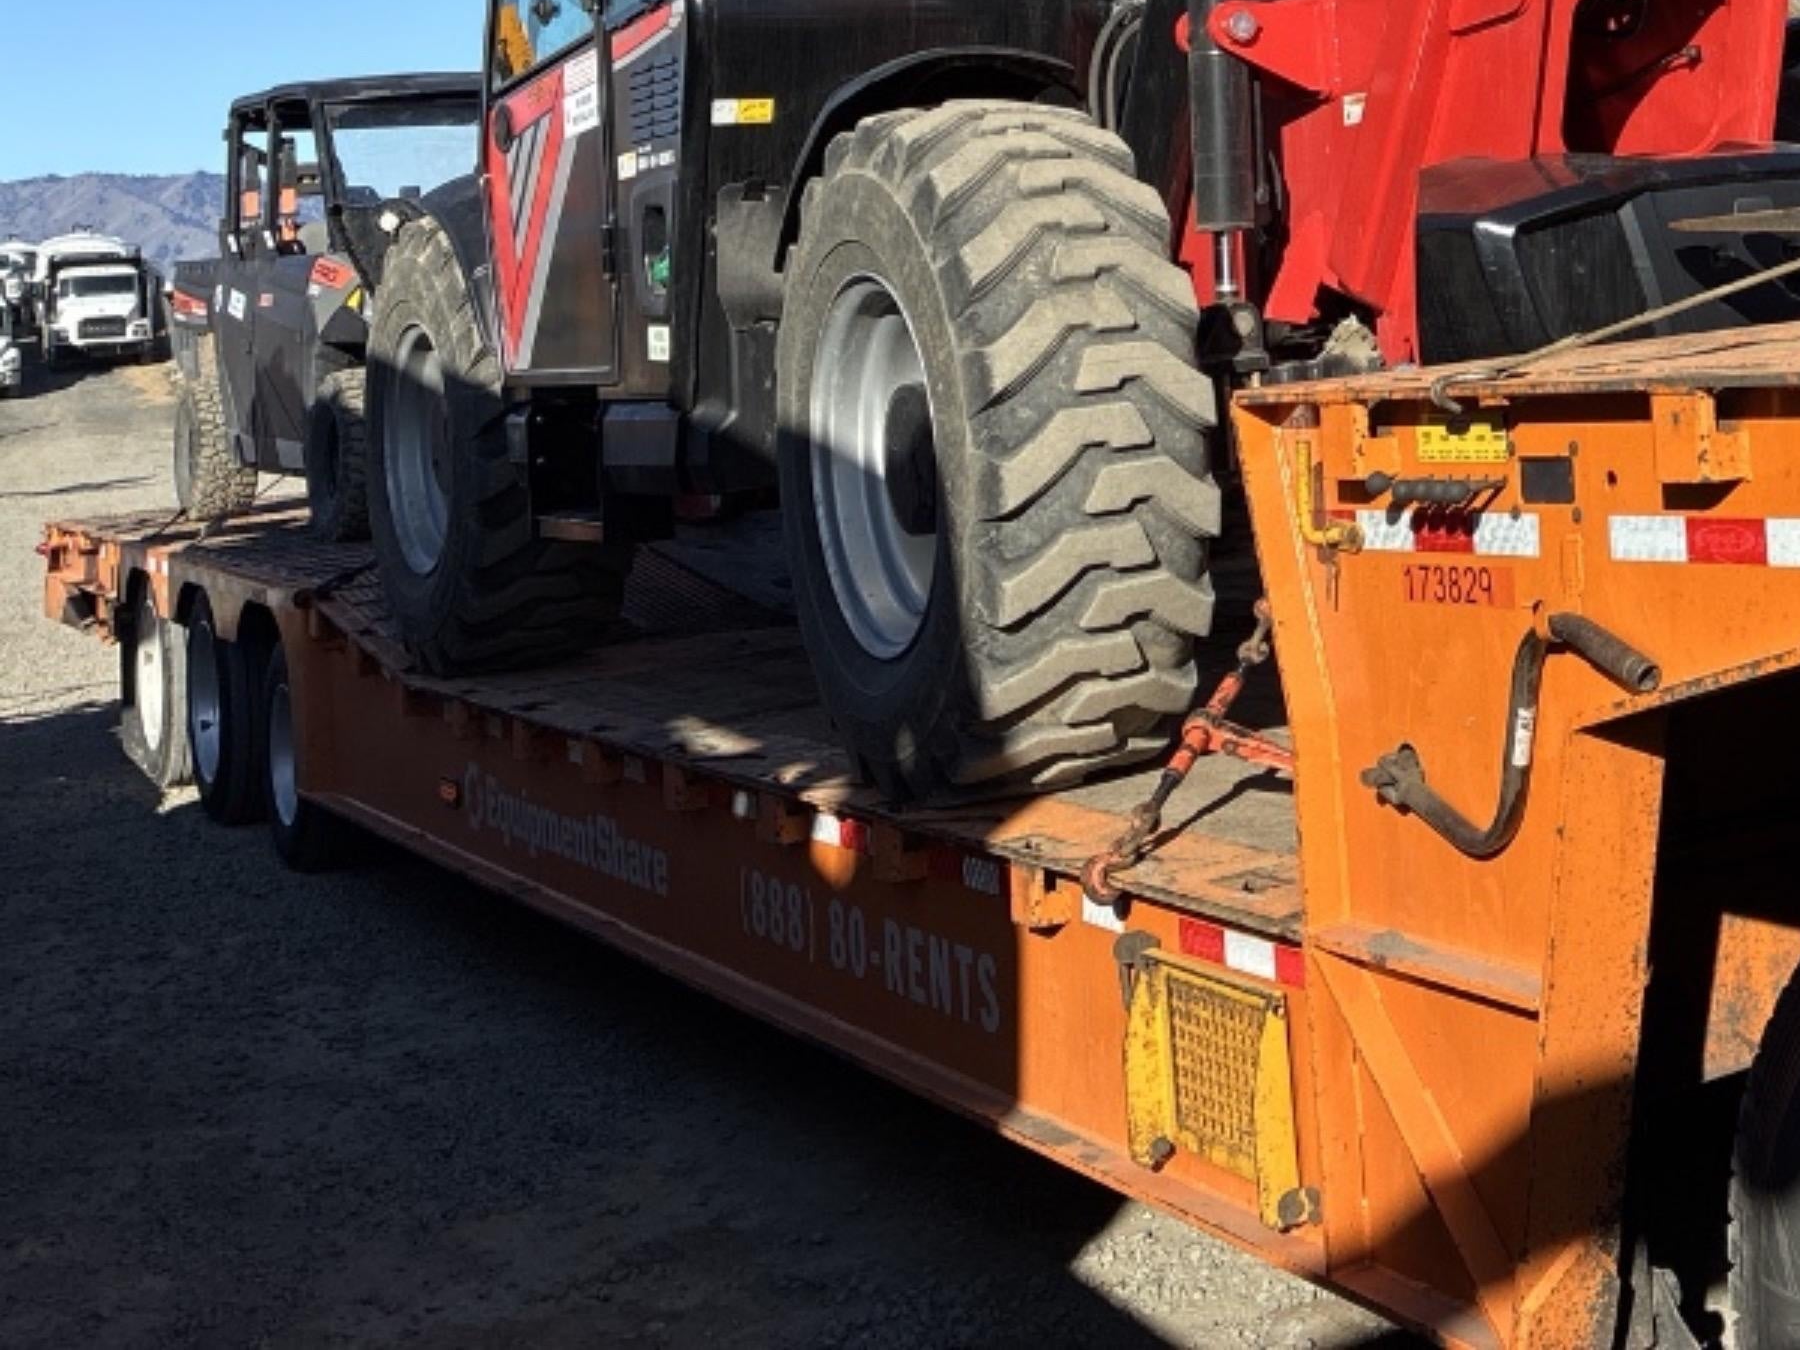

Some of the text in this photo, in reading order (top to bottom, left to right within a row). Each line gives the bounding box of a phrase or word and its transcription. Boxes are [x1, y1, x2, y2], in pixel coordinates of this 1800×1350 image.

[1403, 566, 1492, 605] 173829
[740, 865, 1001, 1034] (888) 80-RENTS
